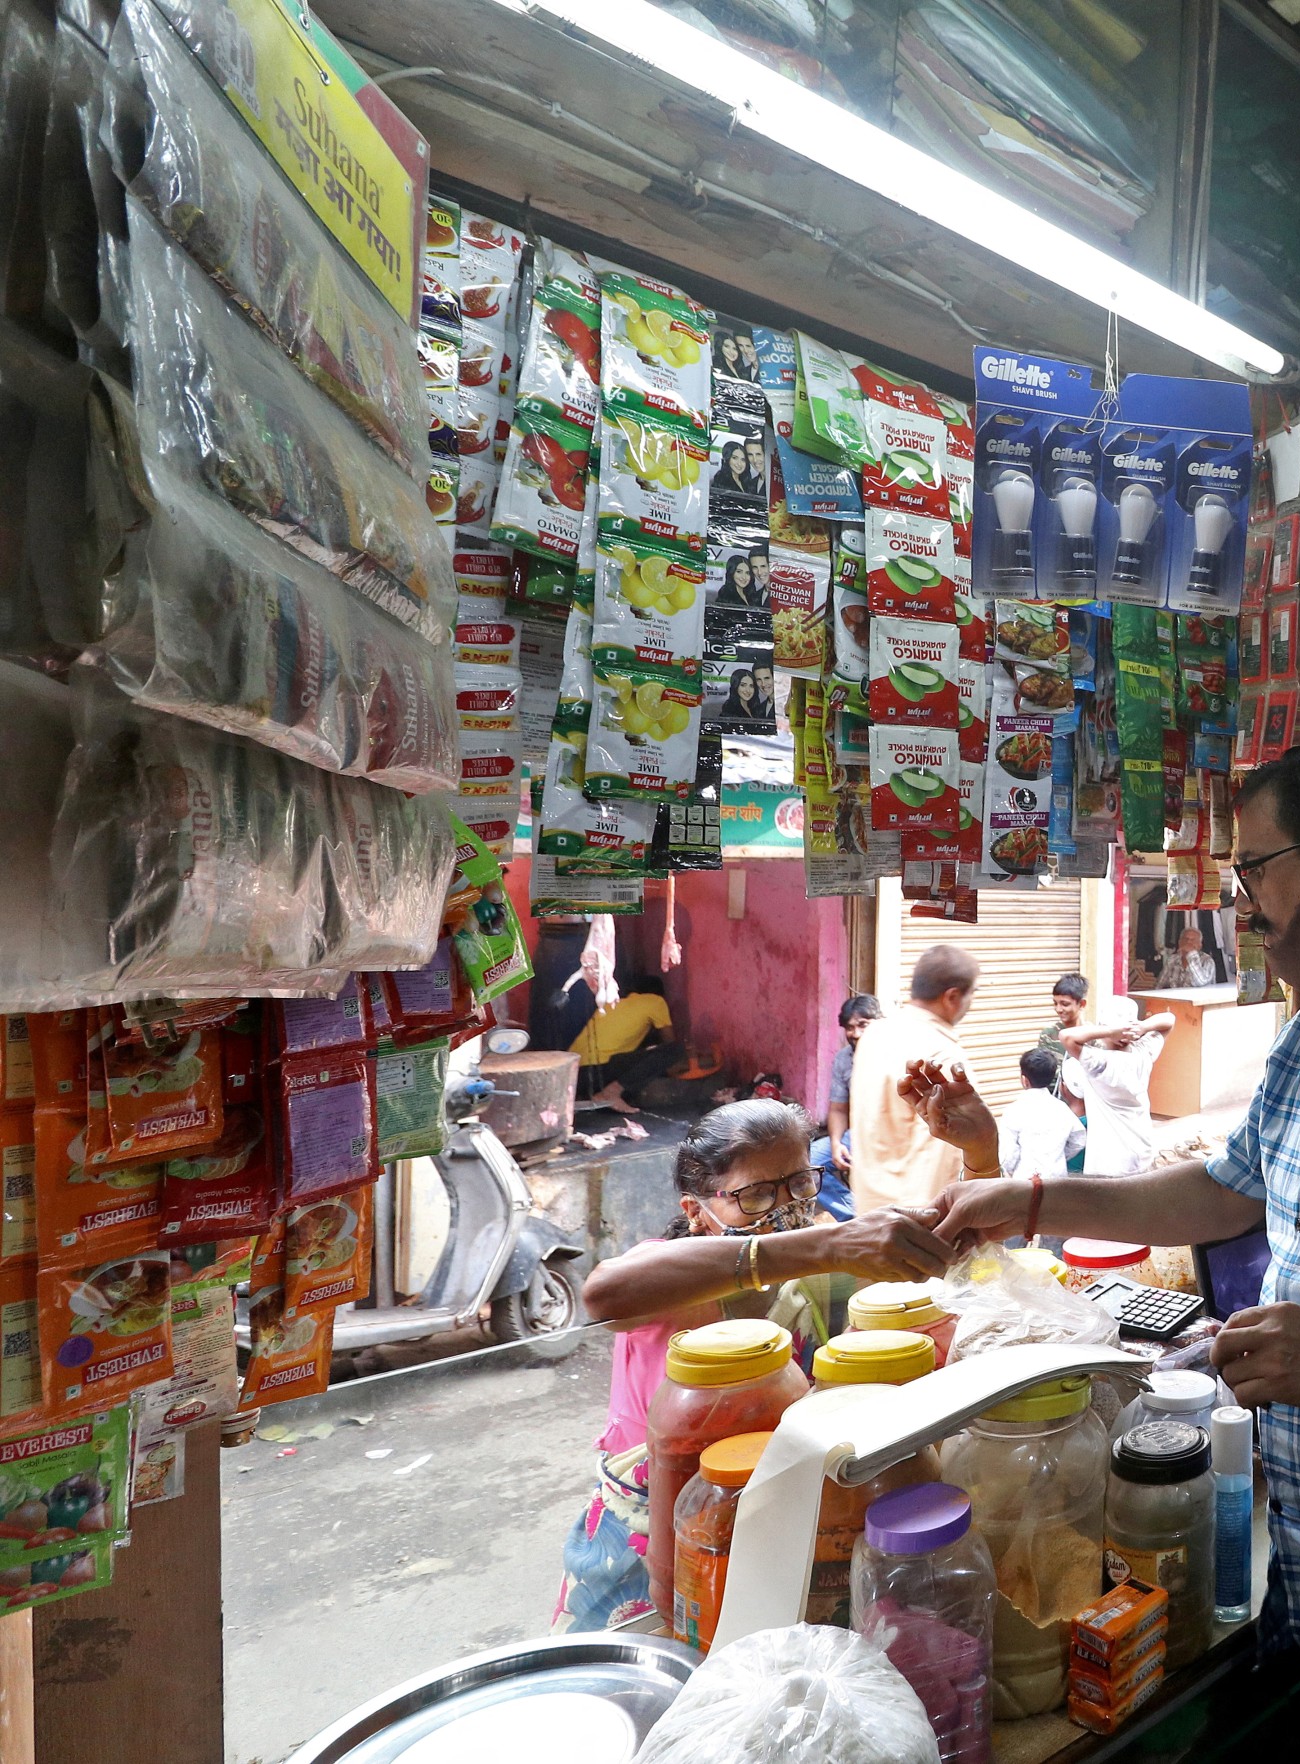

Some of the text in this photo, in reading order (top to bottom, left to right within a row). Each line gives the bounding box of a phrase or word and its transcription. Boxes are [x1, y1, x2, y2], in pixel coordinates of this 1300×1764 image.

[293, 76, 382, 219] Suhana
[981, 356, 1050, 388] Gillette
[1012, 386, 1057, 400] SHAVE BRUSH
[647, 395, 678, 412] priya
[880, 422, 935, 443] AVAKAYA PICKLE
[885, 434, 931, 454] MANGO
[986, 439, 1030, 457] Gillette
[1051, 447, 1093, 465] Gillette
[1113, 455, 1163, 473] Gillette
[1187, 462, 1238, 480] Gillette
[793, 484, 853, 497] TANDOORI
[650, 501, 670, 512] Pickle
[814, 502, 837, 511] priya
[899, 495, 923, 506] priya
[551, 515, 573, 529] Pickle
[649, 509, 671, 522] LIME
[537, 519, 580, 541] OMATO
[644, 522, 675, 537] priya
[882, 529, 942, 545] AAKAYA PICKLE
[541, 536, 576, 554] priya
[889, 540, 937, 557] MANGO
[770, 582, 811, 597] CHEZWAN
[770, 591, 810, 605] RIED RICE
[904, 601, 929, 611] priya
[644, 630, 665, 639] Pickle
[643, 637, 666, 648] LIME
[886, 637, 947, 649] AVAKAYA PICKLE
[301, 611, 321, 709] Suhana
[639, 650, 669, 662] priya
[893, 647, 942, 662] MANGO
[401, 664, 419, 751] Suhana
[906, 707, 931, 718] priya
[1004, 717, 1051, 727] PANEER CHILLI
[888, 743, 947, 754] AVAKAYA PICKLE
[640, 756, 658, 765] Pickle
[894, 753, 943, 767] MANGO
[637, 763, 660, 774] LIME
[633, 777, 662, 788] priya
[908, 813, 932, 823] priya
[595, 821, 619, 833] LIME
[589, 835, 620, 847] priya
[936, 845, 959, 854] priya
[139, 1110, 206, 1139] EVEREST
[195, 1186, 250, 1200] Chicken Masala
[96, 1196, 128, 1208] Masala
[82, 1200, 158, 1231] EVEREST
[186, 1198, 252, 1222] EVEREST
[300, 1276, 356, 1306] EVEREST
[99, 1343, 130, 1357] Masala
[86, 1343, 164, 1382] EVEREST
[260, 1361, 315, 1391] EVEREST
[165, 1405, 201, 1423] Rajesh
[1, 1426, 89, 1462] EVEREST
[42, 1450, 78, 1463] Masala
